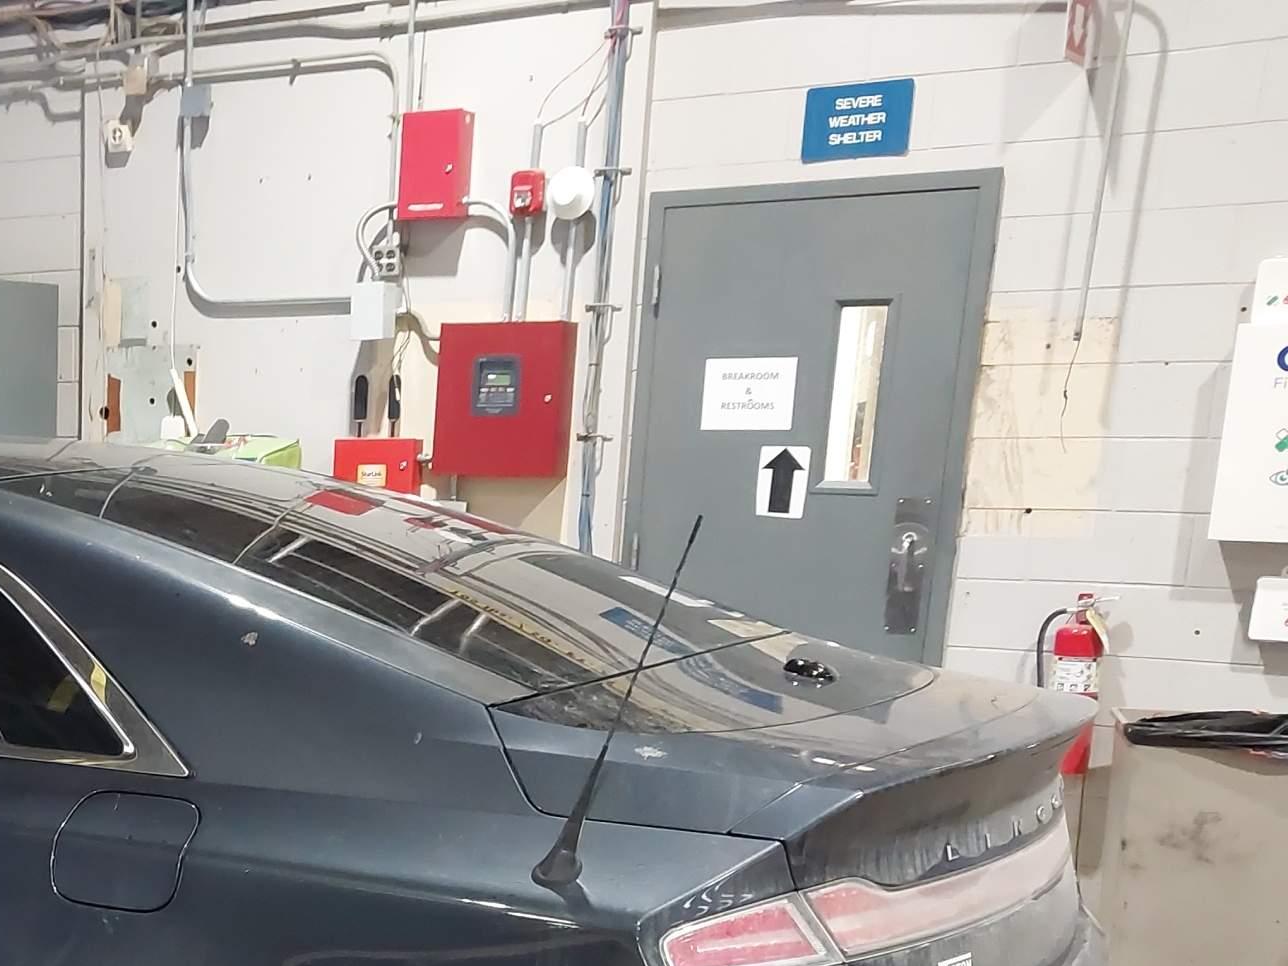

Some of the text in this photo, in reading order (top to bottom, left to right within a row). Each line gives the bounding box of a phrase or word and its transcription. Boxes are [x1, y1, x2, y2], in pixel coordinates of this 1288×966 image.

[834, 94, 884, 111] SEVERE
[828, 111, 887, 128] WEATHER
[828, 129, 882, 146] SHELTER
[721, 371, 780, 381] BREAKROOM
[745, 387, 753, 396] &
[720, 401, 775, 411] RESTROOMS
